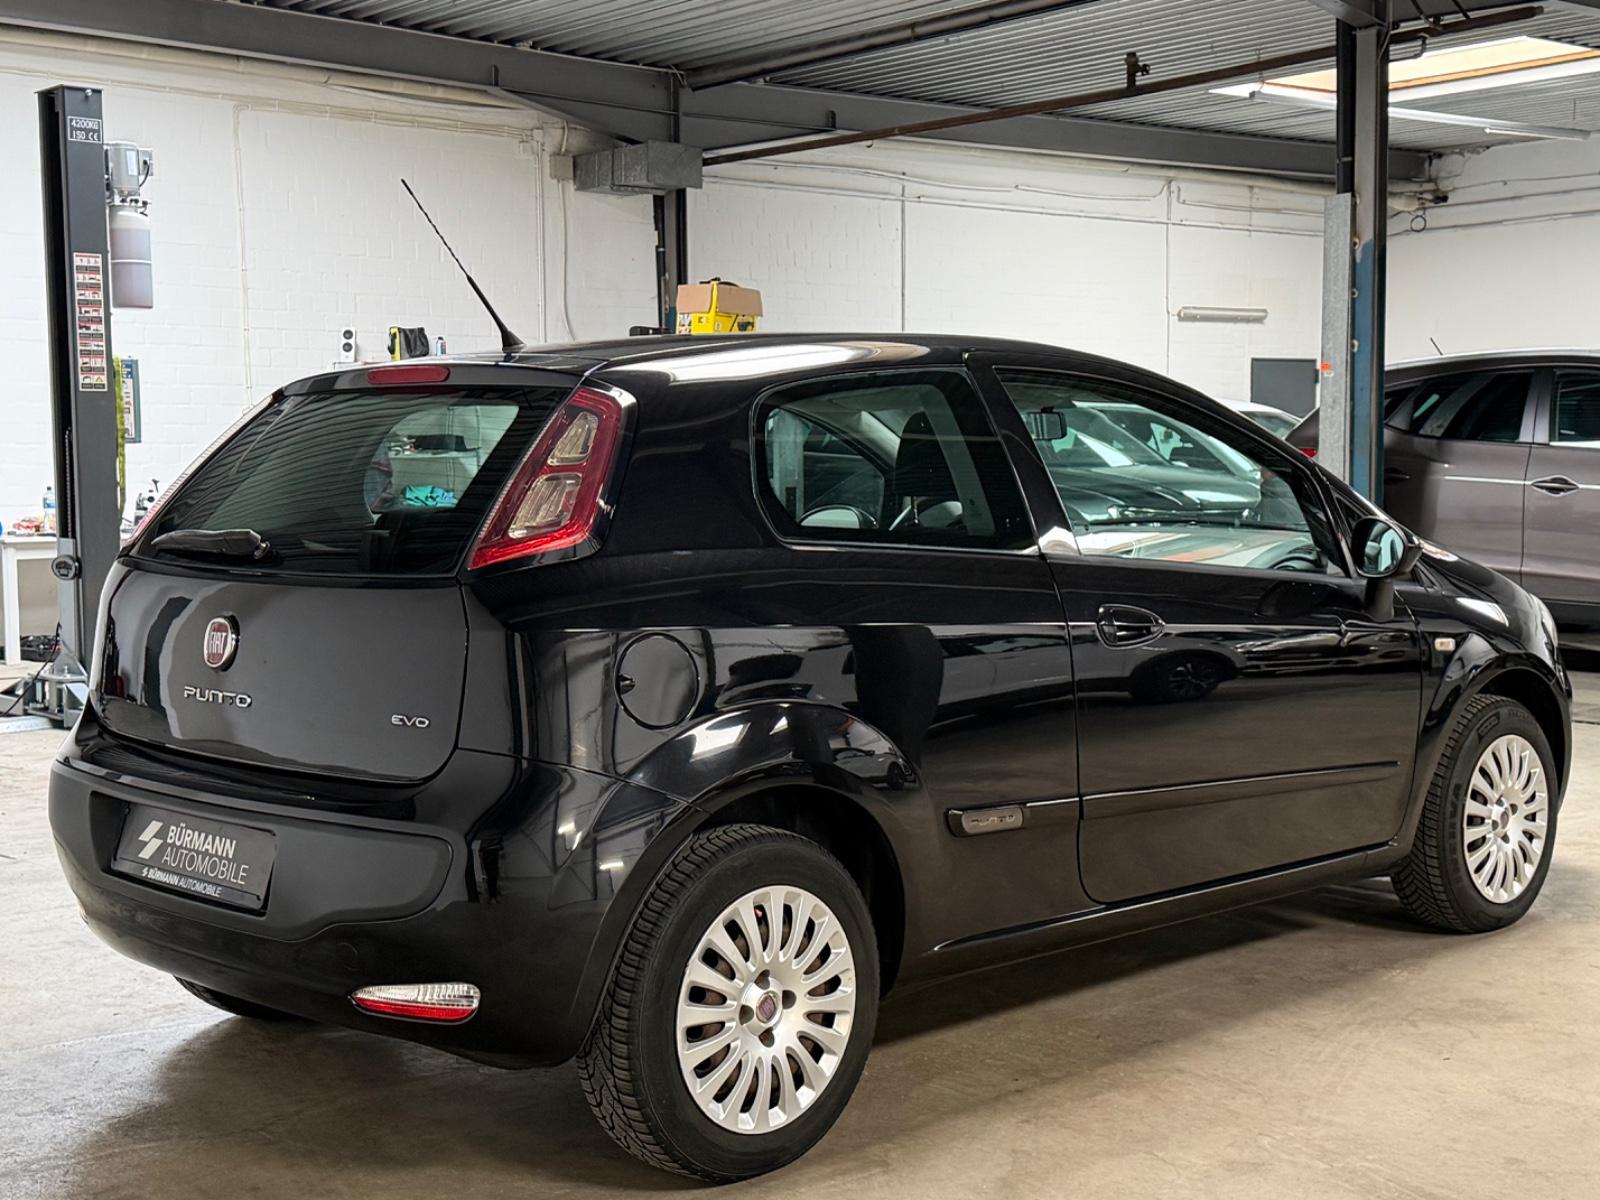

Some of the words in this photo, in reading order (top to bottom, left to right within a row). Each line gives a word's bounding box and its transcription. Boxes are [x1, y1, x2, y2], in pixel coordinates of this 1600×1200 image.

[72, 130, 86, 140] ISO
[208, 631, 228, 655] FIAT
[183, 685, 252, 708] PUNTO
[391, 714, 430, 728] EVO
[166, 822, 237, 859] BÜRMANN
[161, 846, 249, 885] AUTOMOBILE
[147, 867, 180, 886] BÜRMANN
[177, 877, 223, 898] AUTOMOBILE
